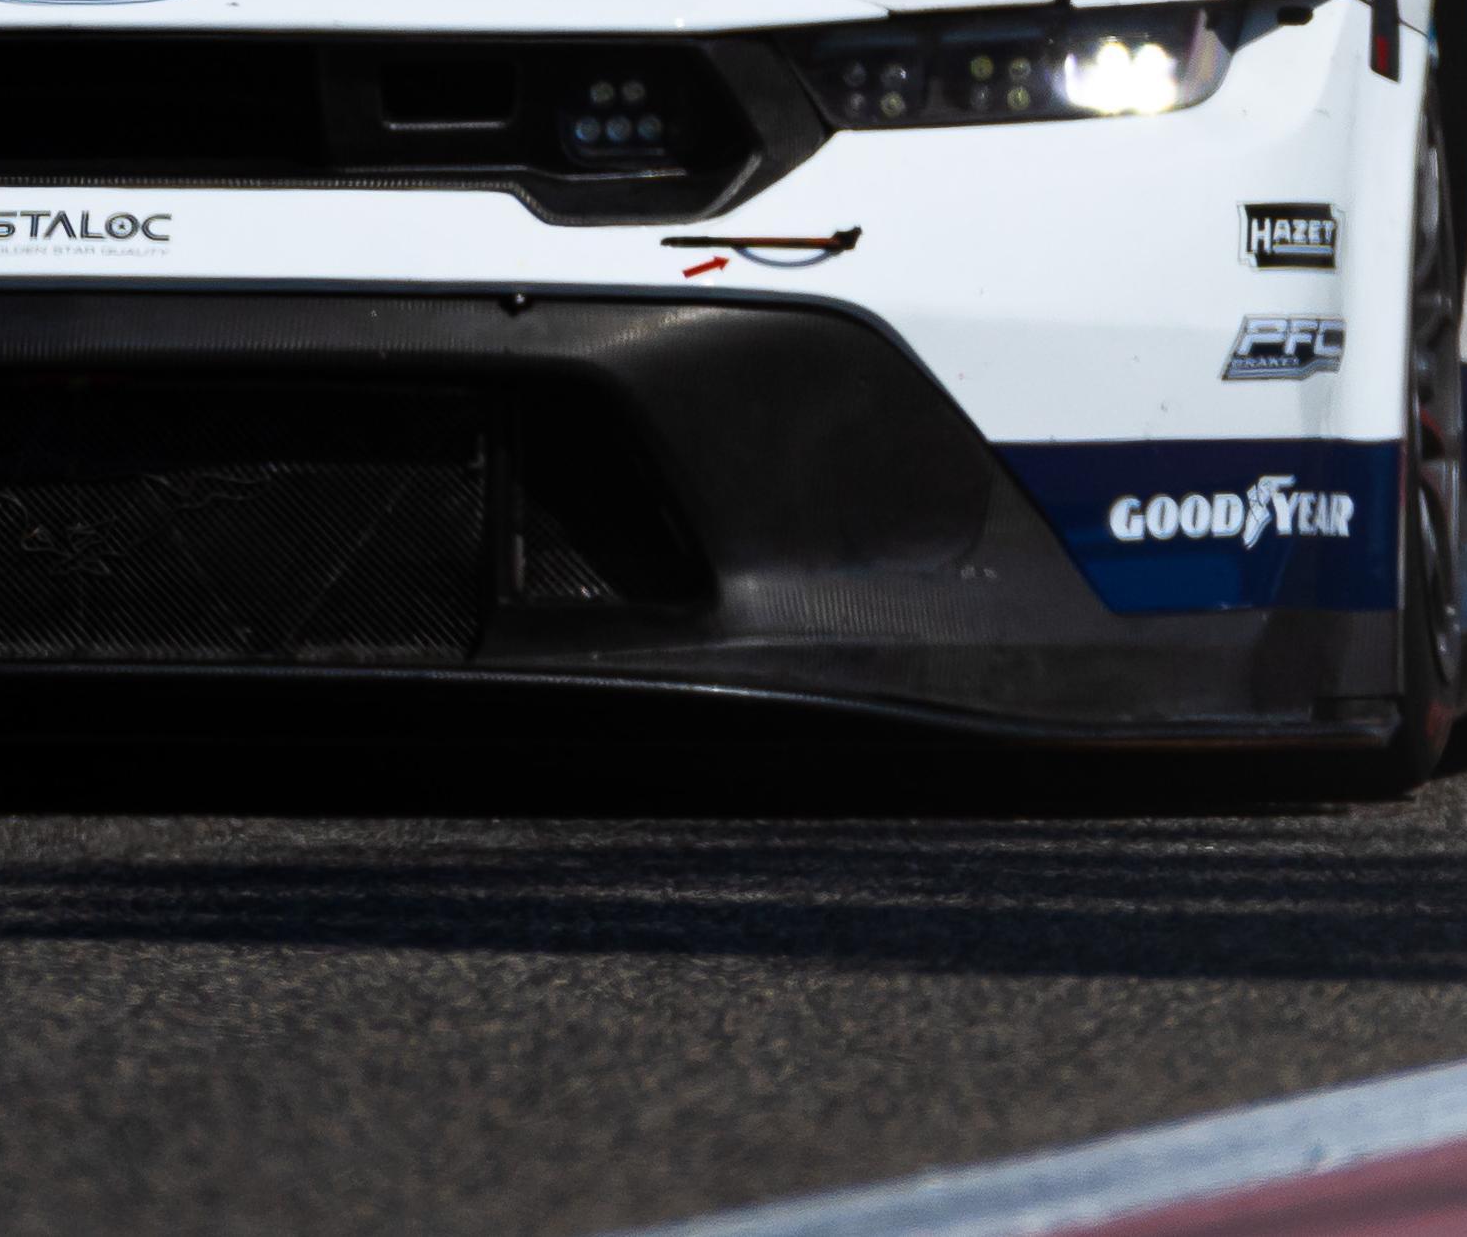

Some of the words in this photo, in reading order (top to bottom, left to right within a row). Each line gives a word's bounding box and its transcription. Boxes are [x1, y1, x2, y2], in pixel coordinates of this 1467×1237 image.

[1251, 218, 1337, 253] HAZET
[1237, 319, 1346, 356] PFC
[1110, 491, 1355, 542] GOODYEAR
